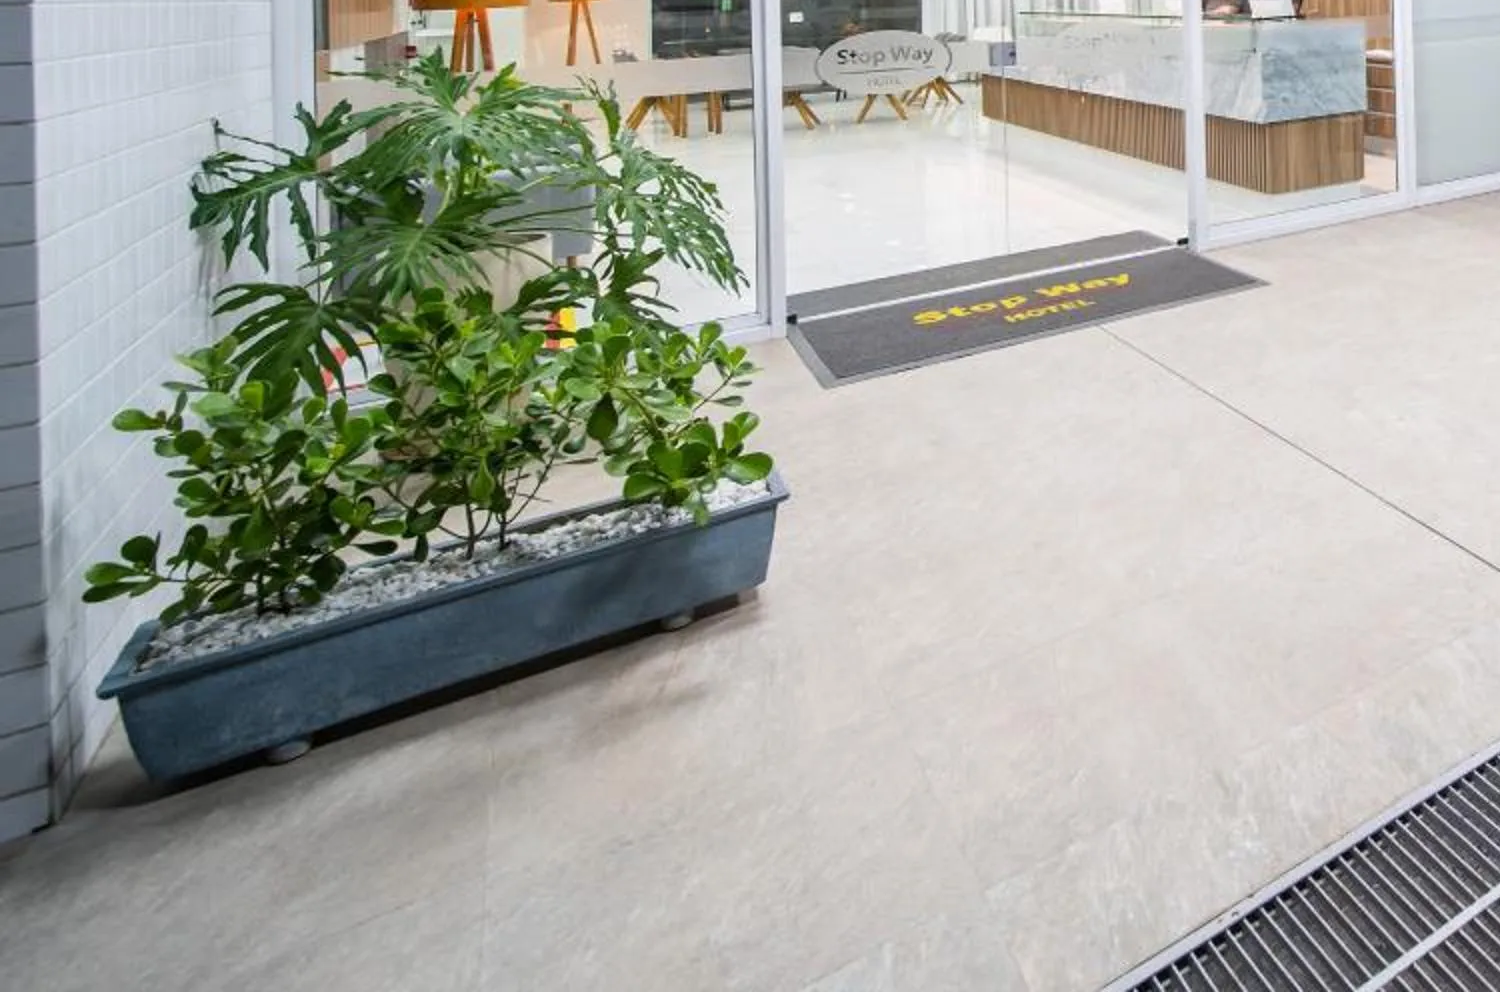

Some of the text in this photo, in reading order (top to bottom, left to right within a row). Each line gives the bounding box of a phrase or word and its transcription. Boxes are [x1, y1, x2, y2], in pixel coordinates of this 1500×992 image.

[836, 45, 934, 67] Stop Way
[913, 273, 1130, 325] Stop Way
